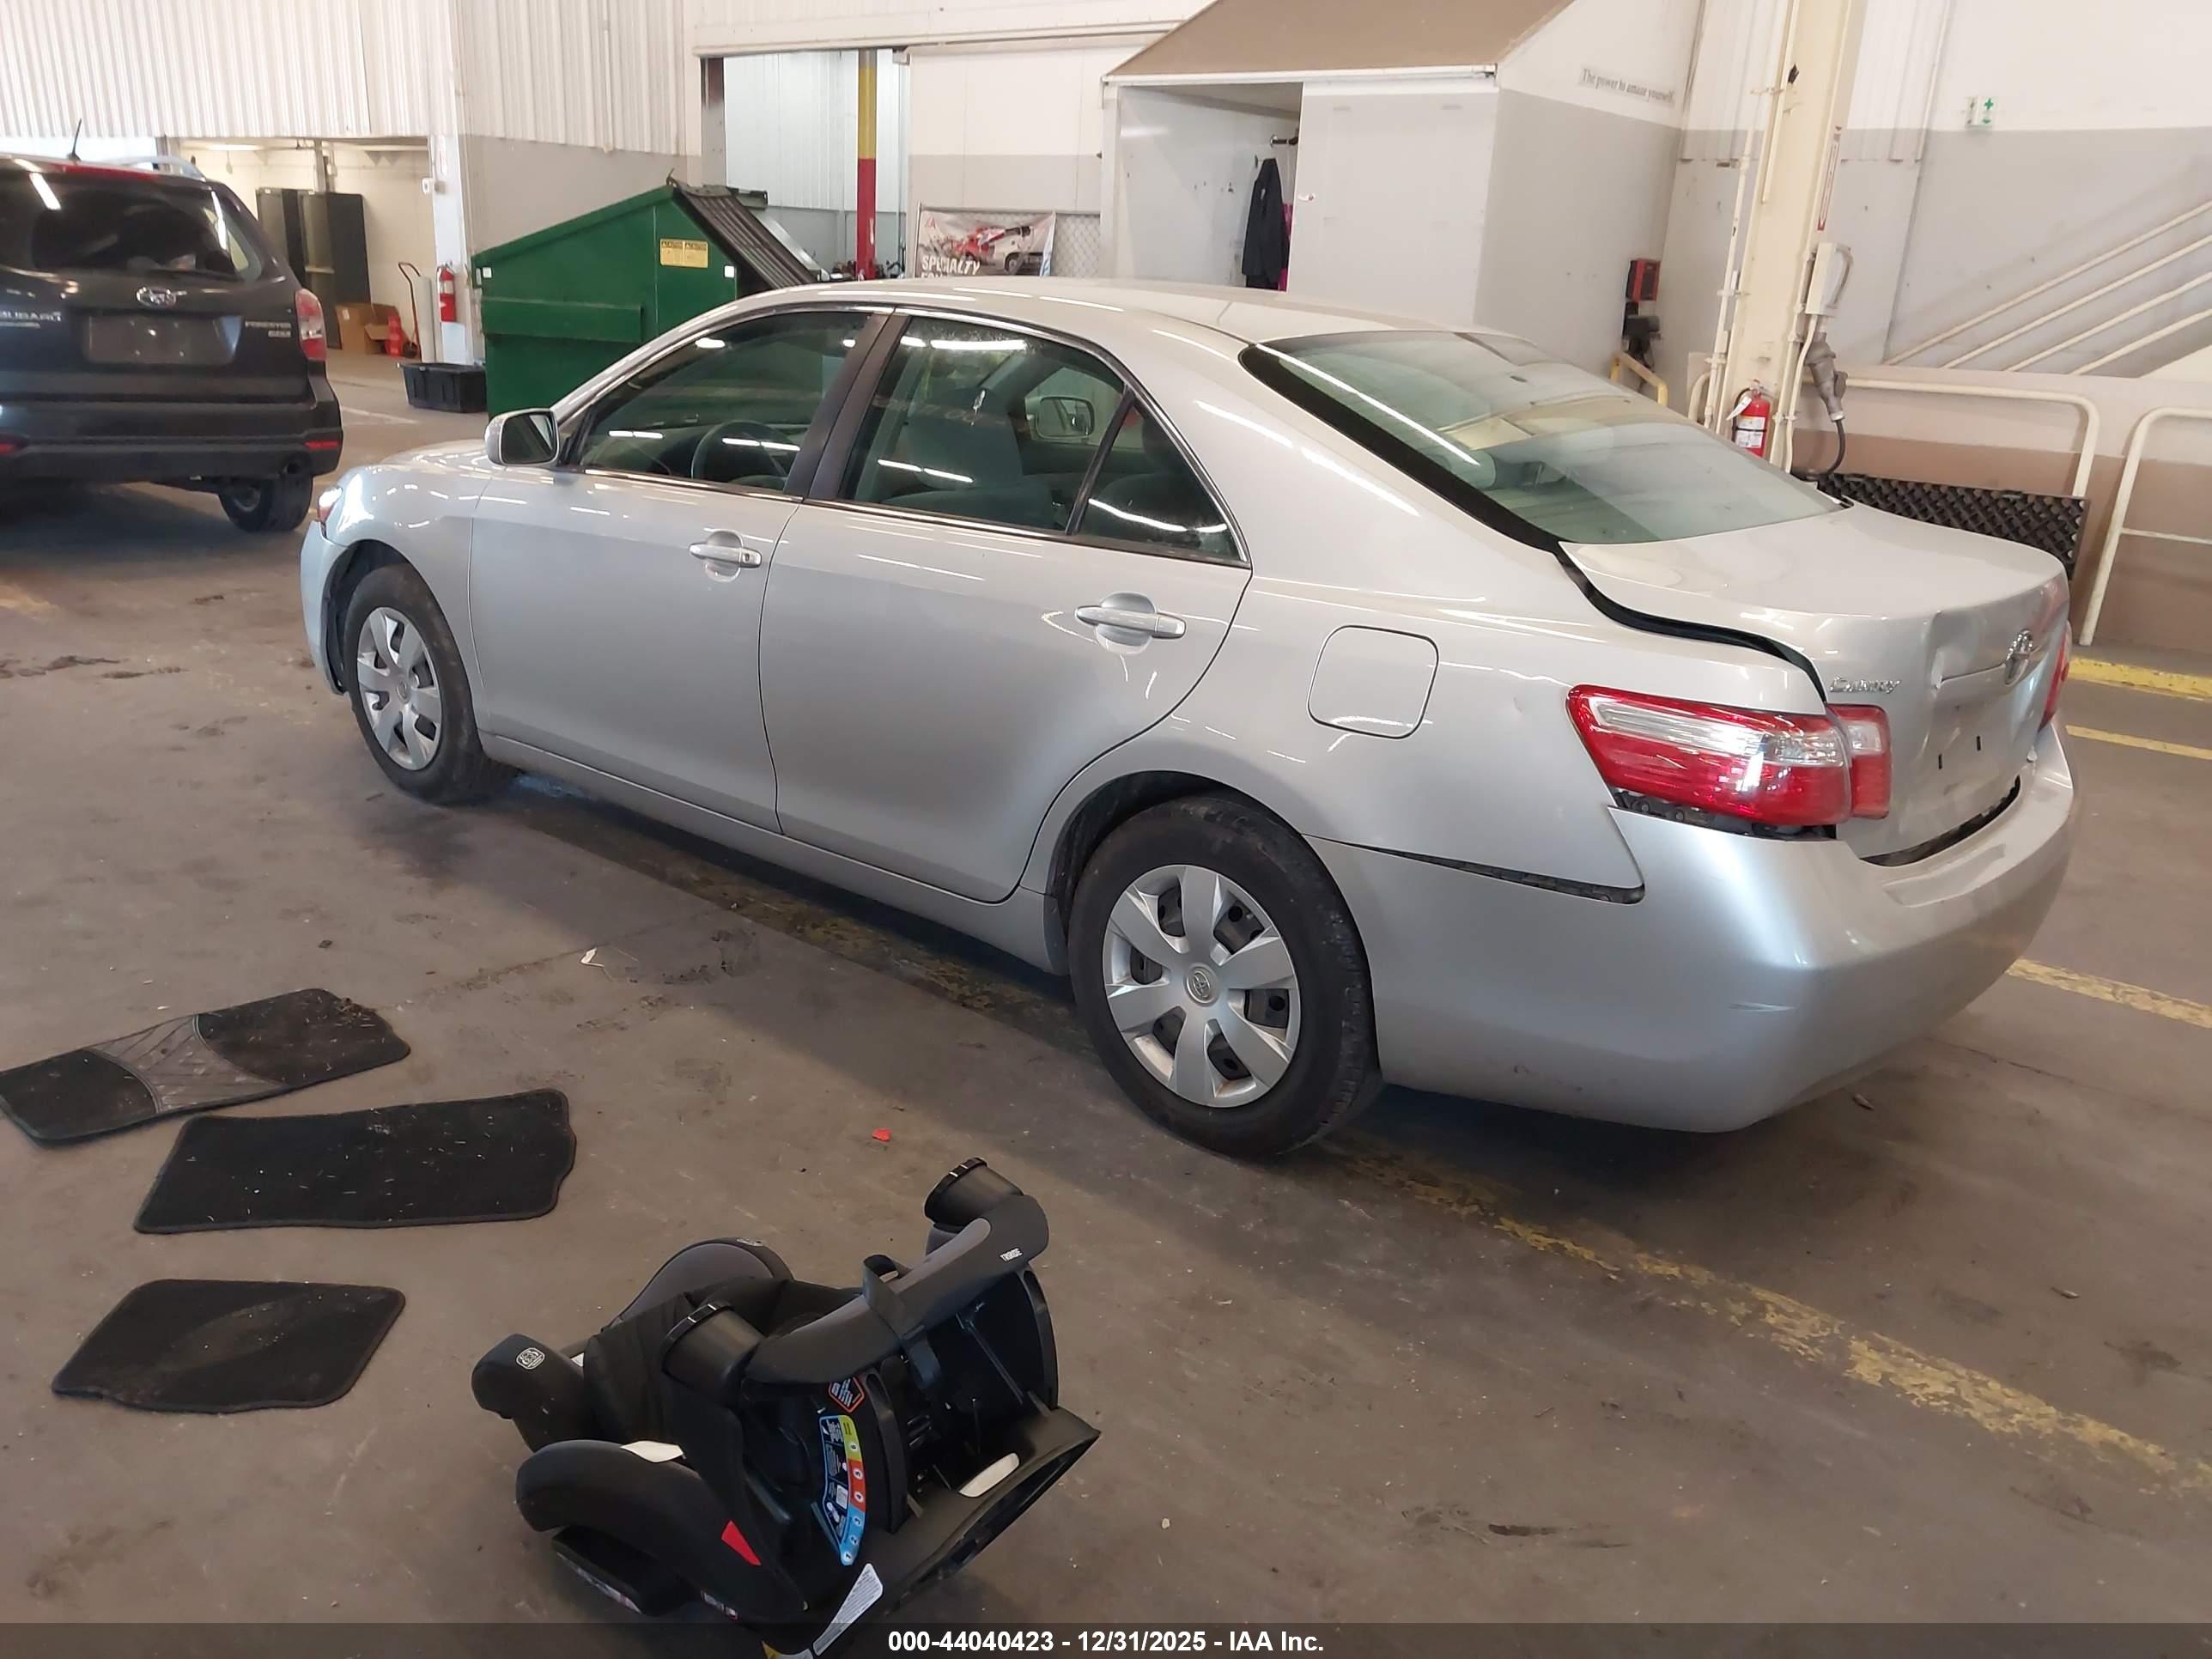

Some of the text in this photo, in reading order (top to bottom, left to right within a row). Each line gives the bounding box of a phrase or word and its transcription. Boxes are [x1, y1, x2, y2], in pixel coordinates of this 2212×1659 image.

[1583, 68, 1596, 83] The
[1595, 76, 1619, 89] power
[921, 256, 981, 276] SPECIALTY
[1829, 675, 1901, 695] Camry
